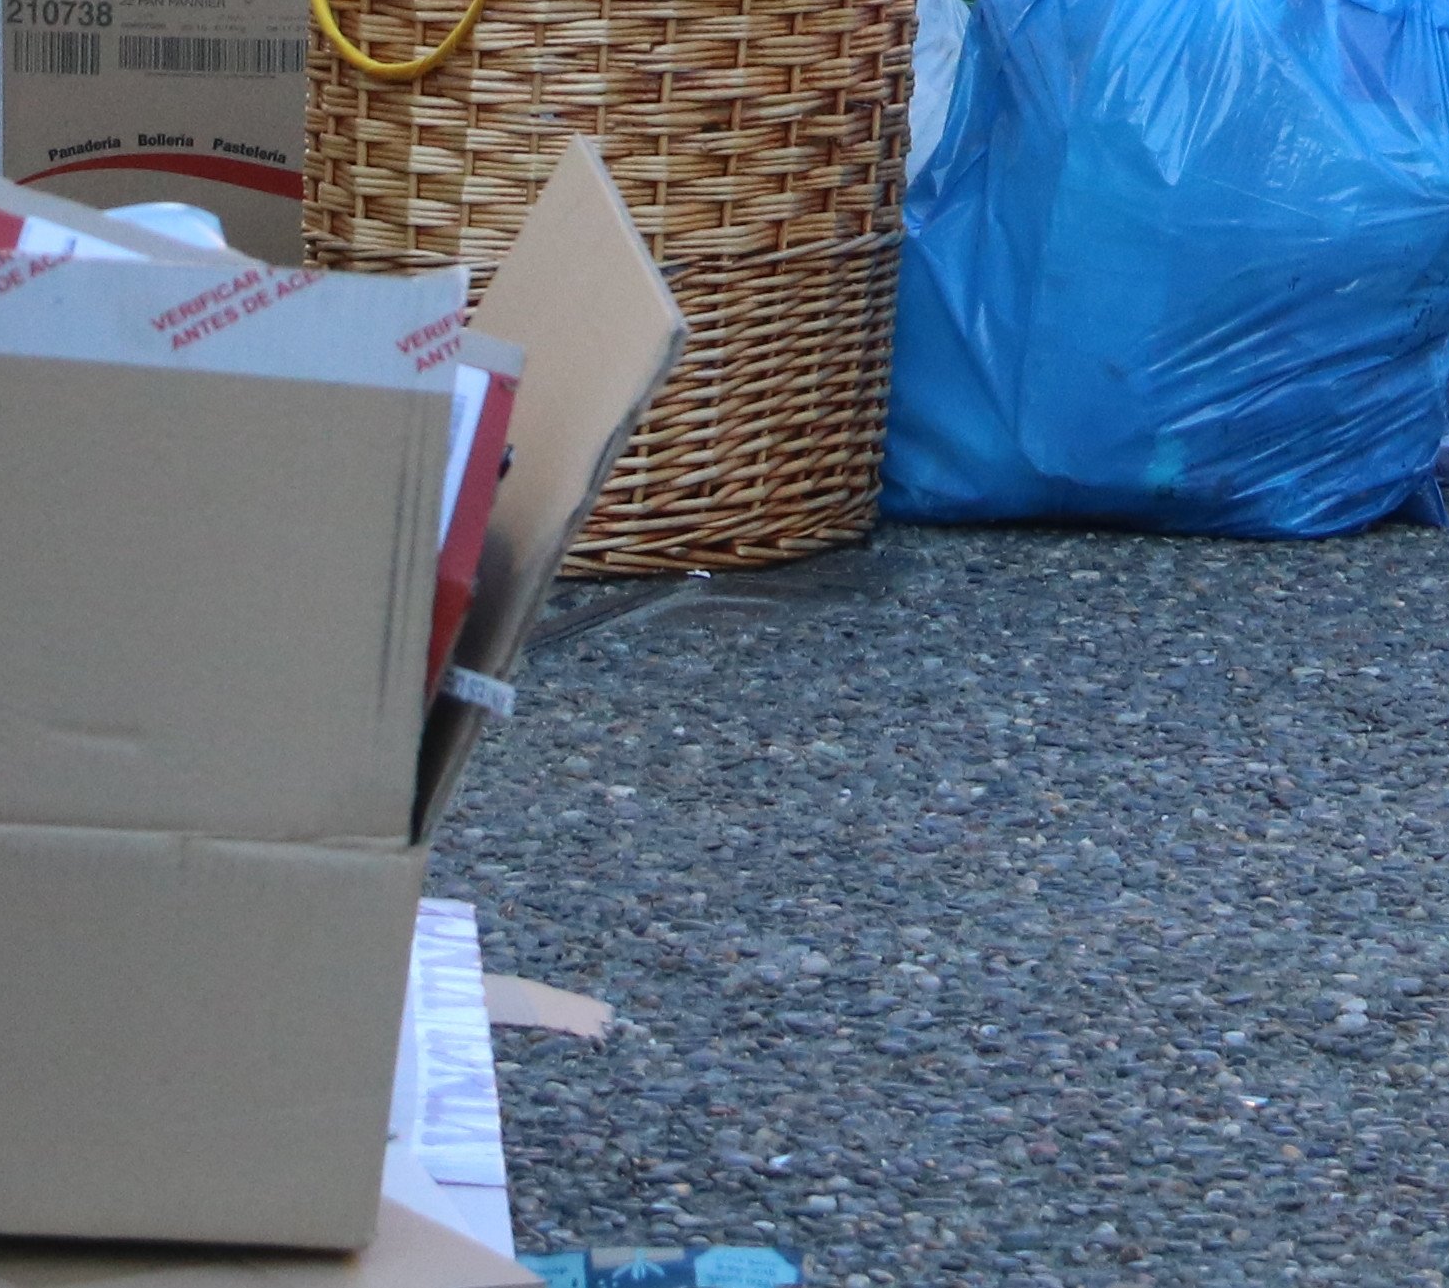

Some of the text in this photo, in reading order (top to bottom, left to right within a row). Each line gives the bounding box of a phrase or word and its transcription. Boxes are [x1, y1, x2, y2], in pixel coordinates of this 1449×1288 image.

[48, 132, 287, 165] Panadería Bollería Pastelería
[171, 307, 240, 352] ANTES
[242, 290, 271, 315] DE
